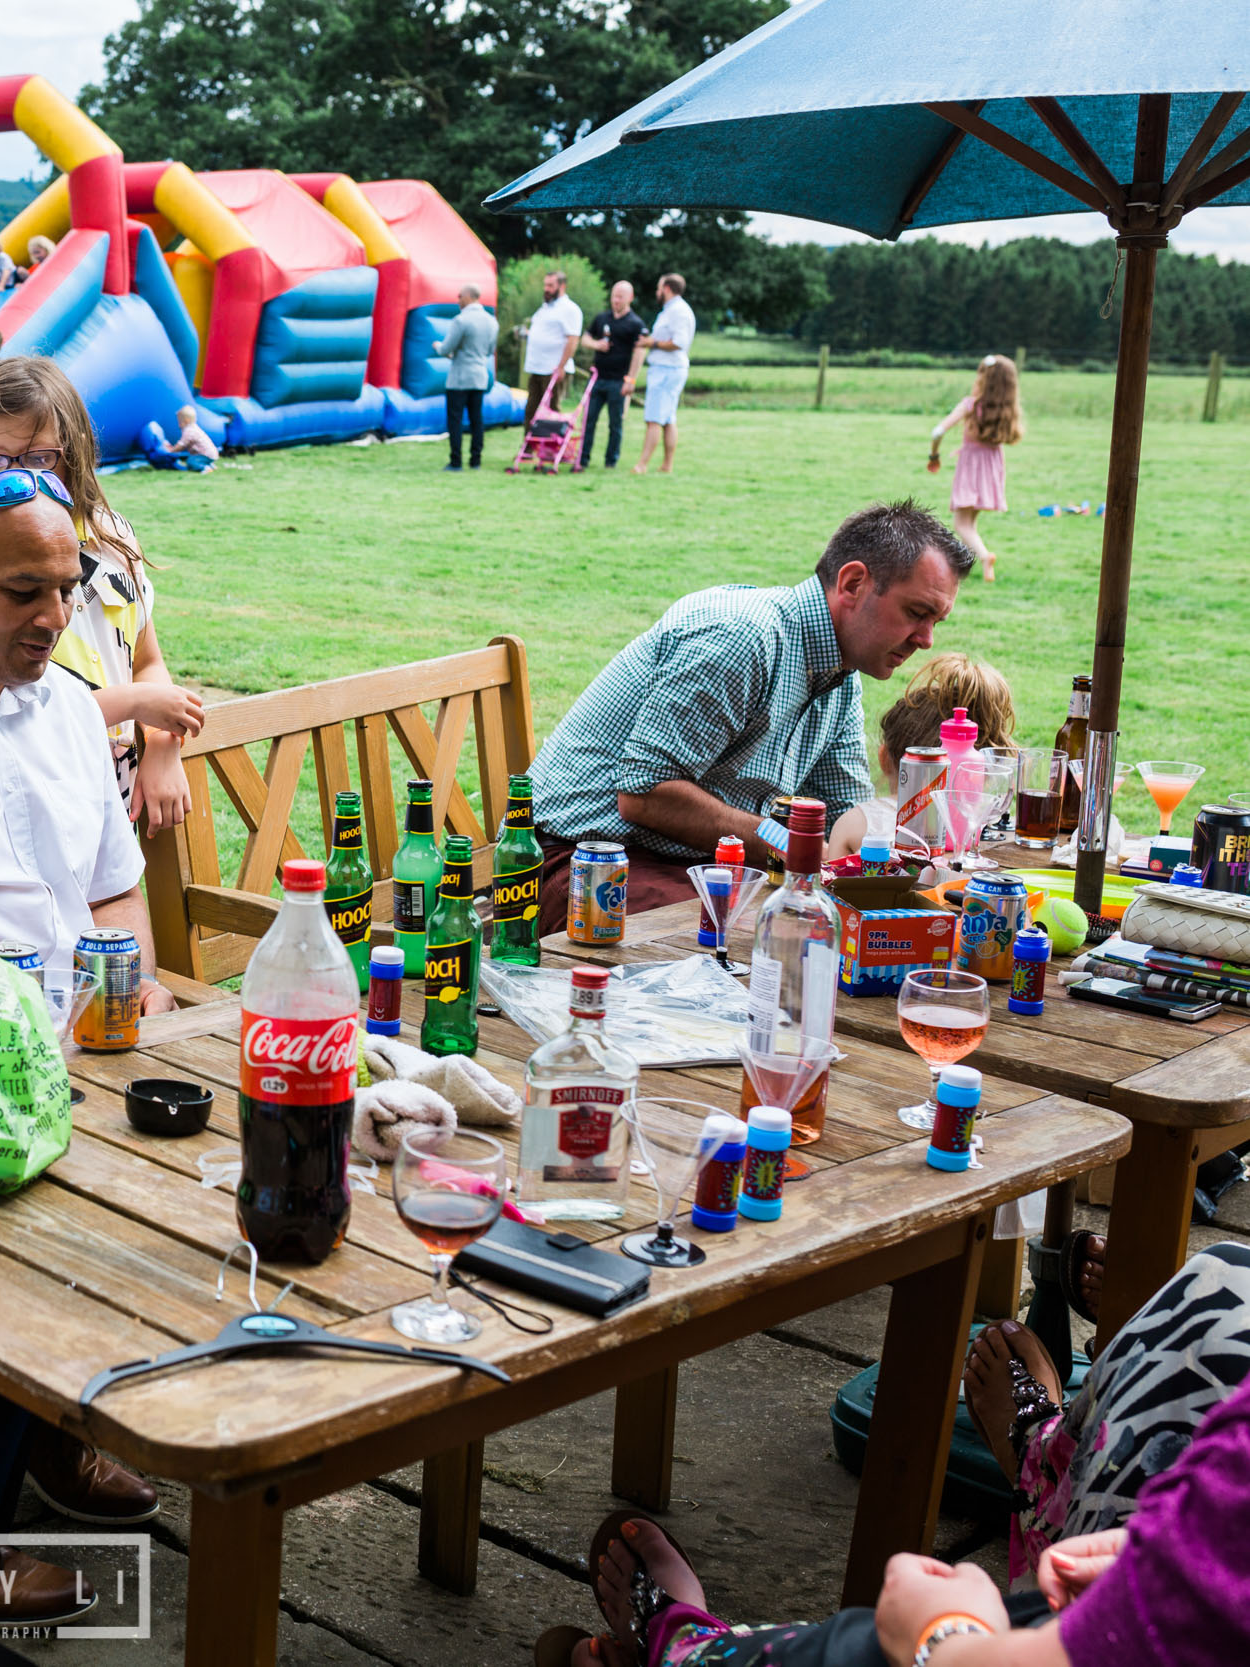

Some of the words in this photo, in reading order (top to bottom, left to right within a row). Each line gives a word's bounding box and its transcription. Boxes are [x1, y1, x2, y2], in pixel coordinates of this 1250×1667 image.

[506, 806, 531, 820] HOOCH
[339, 825, 362, 841] HOOC
[1225, 834, 1250, 849] BR
[442, 873, 461, 888] OOCH
[494, 877, 539, 905] HOOCH
[331, 901, 372, 931] HOOC
[962, 908, 1008, 936] anta
[868, 931, 889, 940] 9PK
[85, 941, 103, 951] SOLD
[867, 941, 913, 949] BUBBLES
[22, 957, 32, 967] BE
[425, 956, 461, 983] OOCH
[244, 1017, 356, 1074] Coca-Col
[46, 1078, 69, 1101] afte
[554, 1087, 621, 1104] SMIRNOFF
